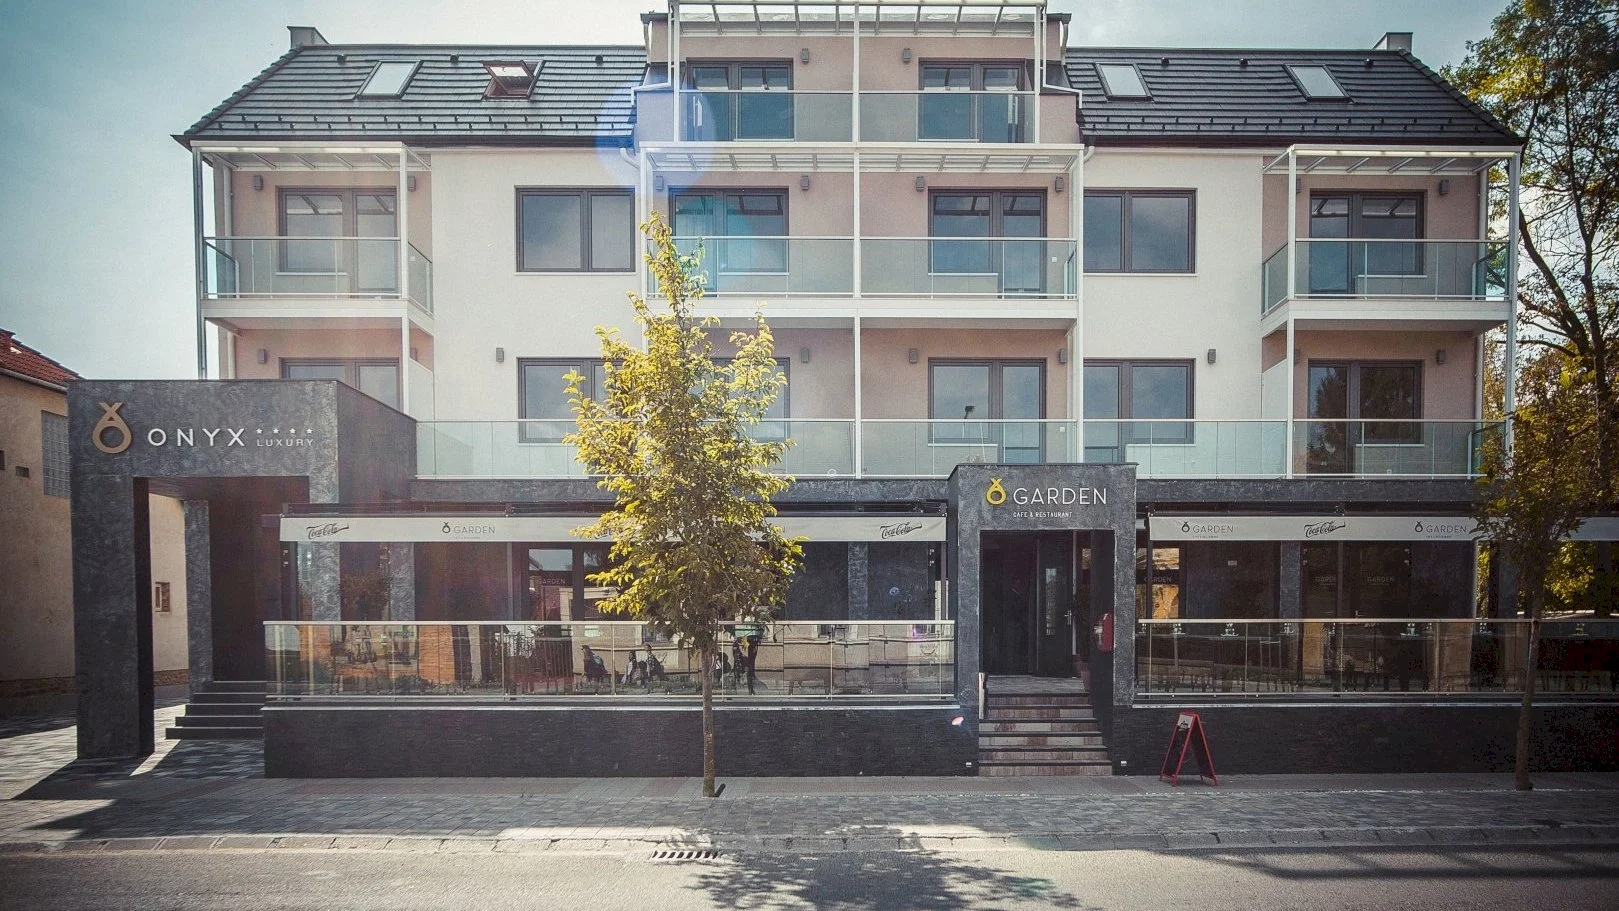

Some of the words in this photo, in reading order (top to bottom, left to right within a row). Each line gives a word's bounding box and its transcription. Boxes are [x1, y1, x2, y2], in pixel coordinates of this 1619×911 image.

[147, 428, 245, 447] ONYX
[256, 438, 314, 447] LUXURY
[1013, 487, 1107, 505] GARDEN
[453, 525, 496, 534] GARDEN
[1192, 524, 1234, 533] GARDEN
[1425, 524, 1467, 533] GARDEN
